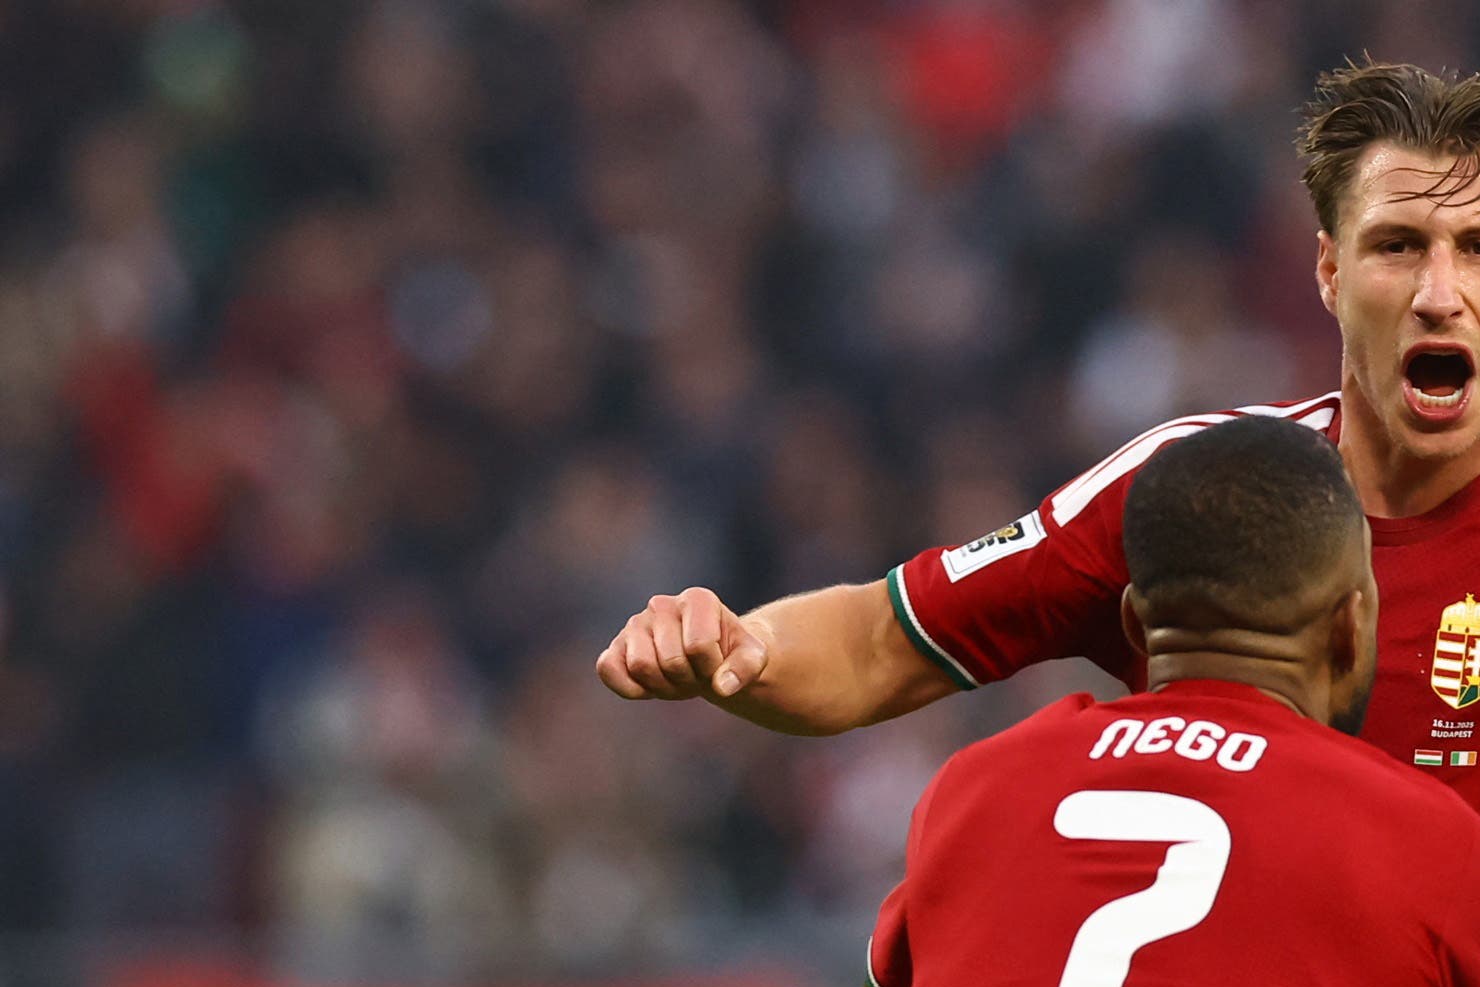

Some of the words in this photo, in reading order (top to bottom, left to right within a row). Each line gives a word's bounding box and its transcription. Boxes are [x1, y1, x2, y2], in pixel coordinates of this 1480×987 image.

[1432, 719, 1475, 729] 16.11.2025
[1431, 729, 1473, 738] BUDAPEST
[1088, 716, 1268, 772] NEGO
